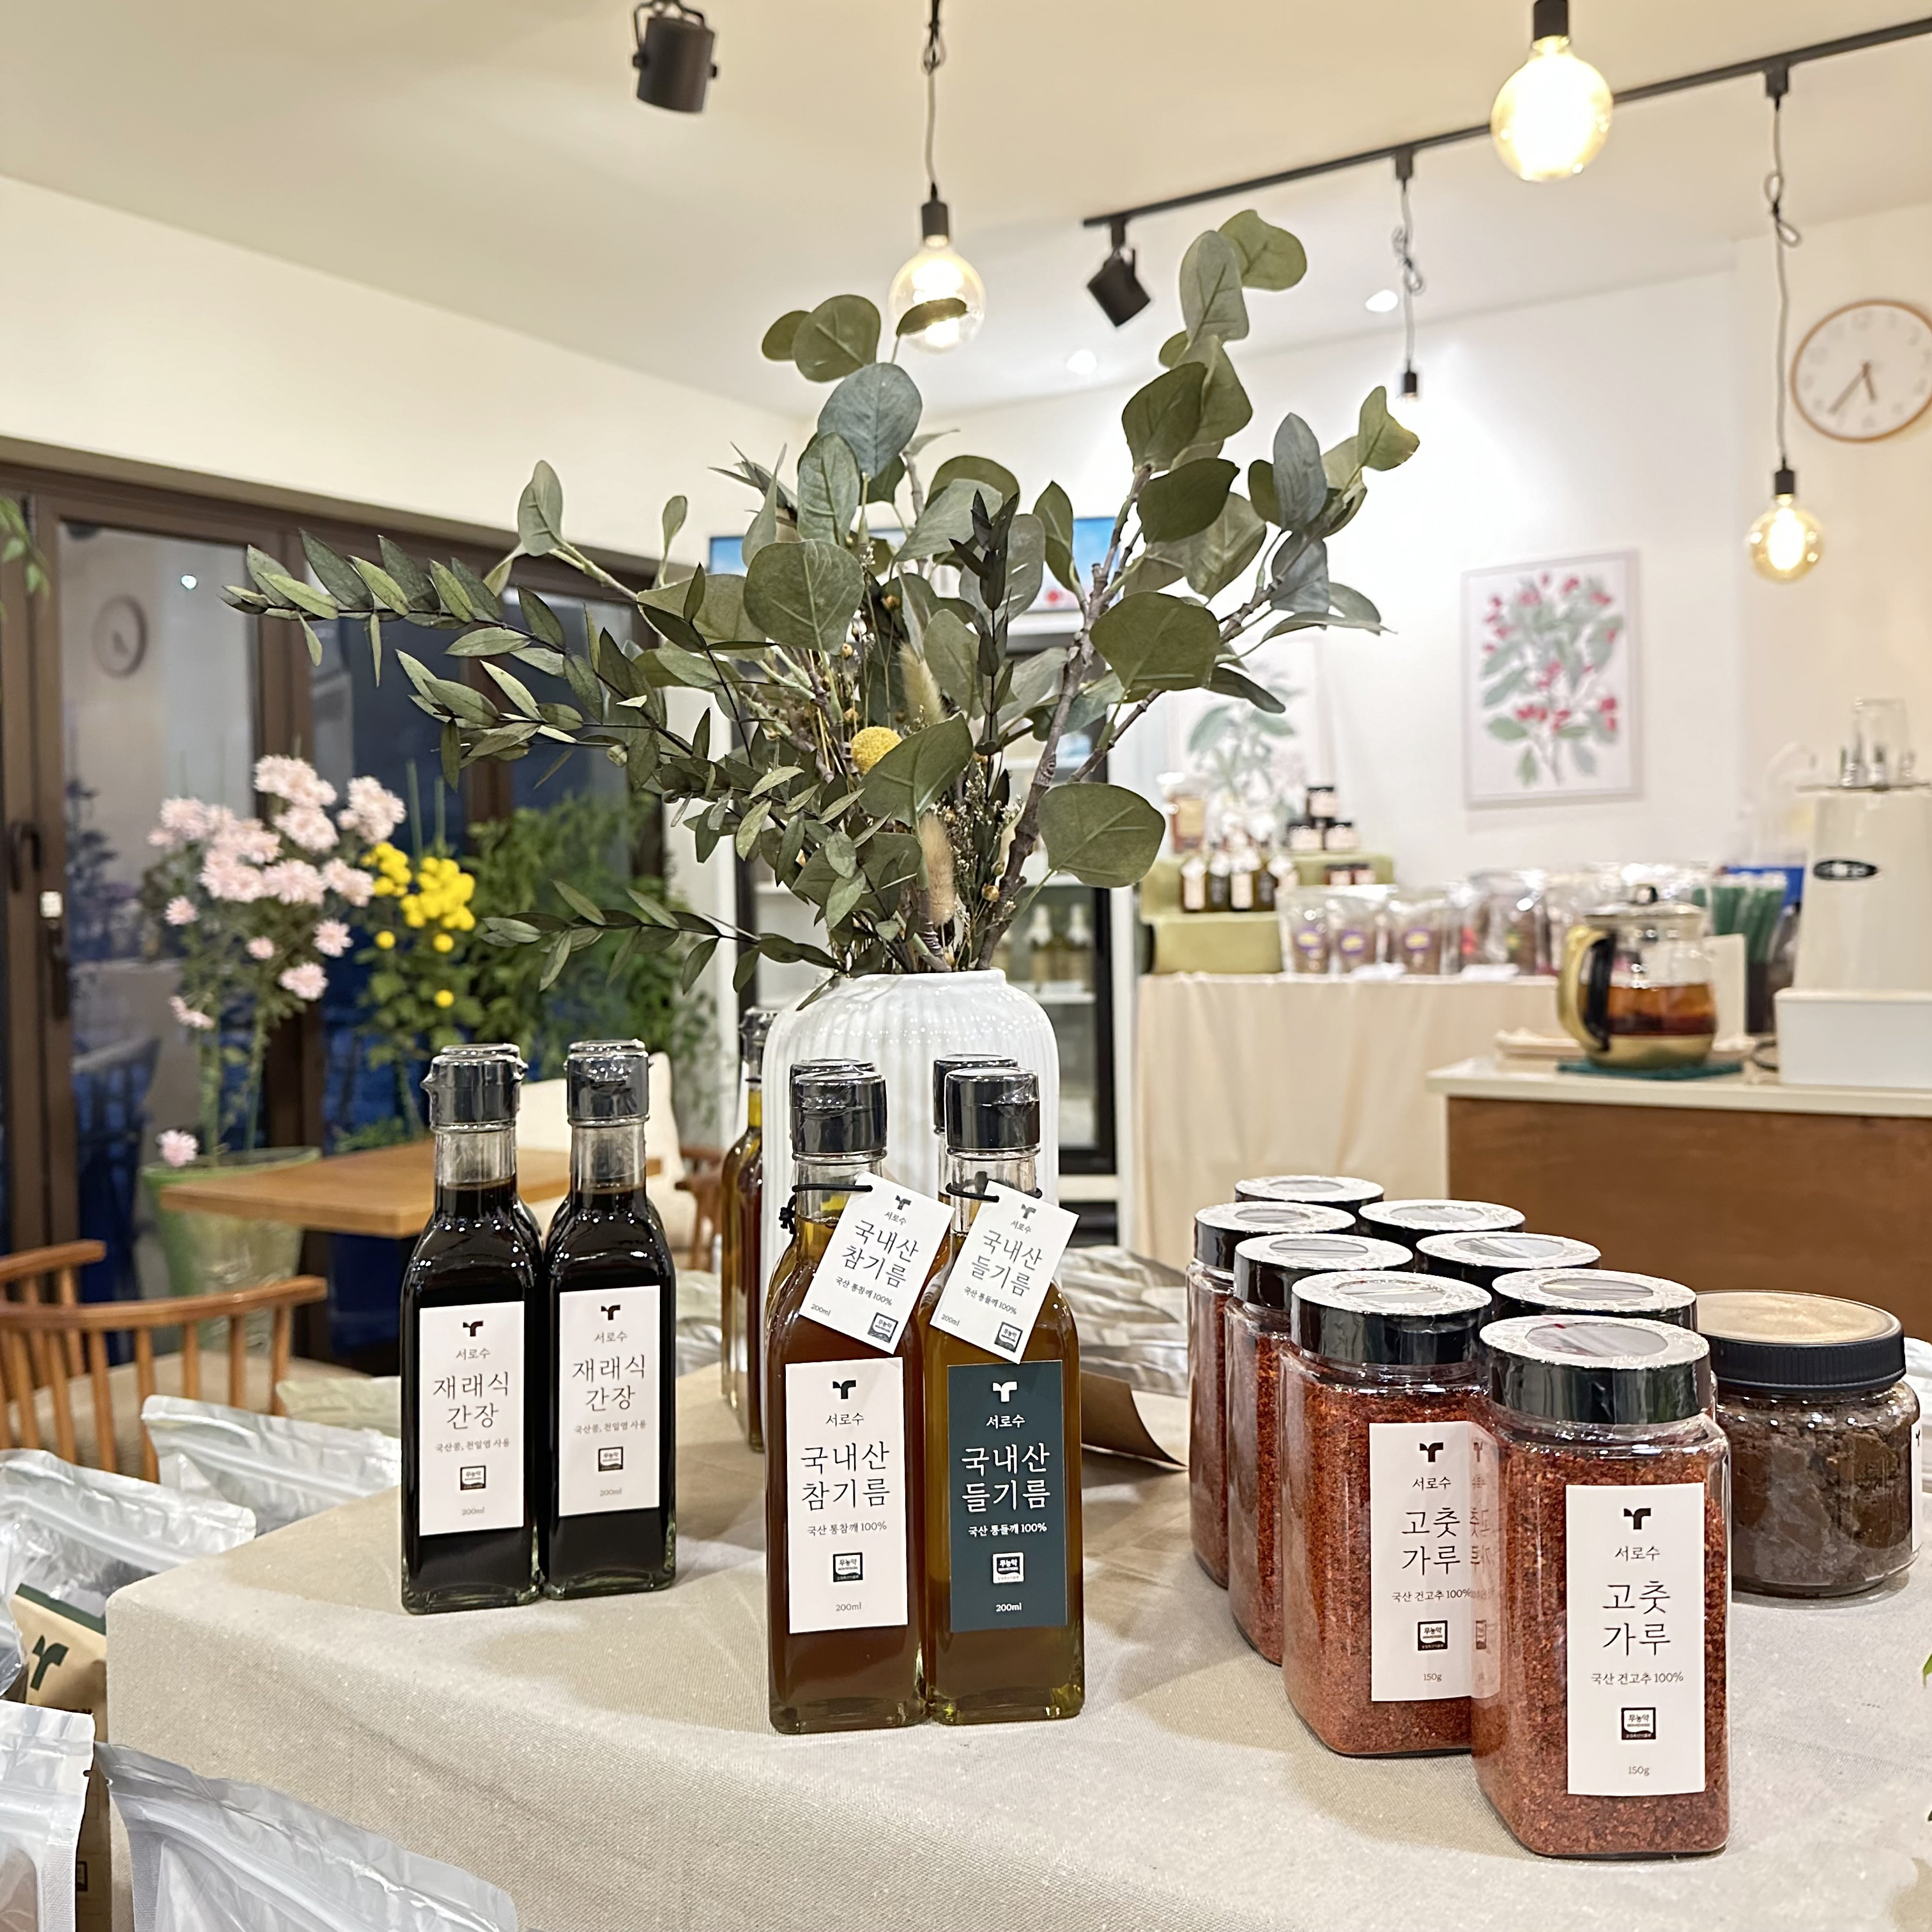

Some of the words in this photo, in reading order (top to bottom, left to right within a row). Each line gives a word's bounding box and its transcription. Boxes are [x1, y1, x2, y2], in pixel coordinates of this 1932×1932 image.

[884, 1211, 907, 1226] 서로수
[1010, 1220, 1032, 1234] 서로수
[855, 1220, 920, 1264] 국내산
[983, 1229, 1043, 1272] 국내산
[842, 1245, 907, 1289] 참기름
[972, 1255, 1031, 1297] 들기름
[836, 1276, 850, 1289] 국산
[873, 1292, 893, 1307] 100%
[964, 1285, 978, 1298] 국산
[999, 1301, 1017, 1315] 100%
[810, 1303, 831, 1317] 200ml
[941, 1313, 960, 1326] 200ml
[594, 1331, 627, 1344] 서로수
[456, 1347, 491, 1361] 서로수
[572, 1354, 645, 1383] 재래식
[433, 1371, 509, 1400] 재래식
[585, 1384, 636, 1412] 간장
[447, 1402, 499, 1430] 간장
[825, 1412, 864, 1427] 서로수
[986, 1414, 1025, 1430] 서로수
[801, 1440, 890, 1475] 국내산
[961, 1442, 1050, 1477] 국내산
[599, 1487, 622, 1497] 200ml
[1412, 1476, 1452, 1491] 서로수
[801, 1478, 891, 1512] 참기름
[962, 1479, 1051, 1513] 들기름
[461, 1506, 486, 1516] 200ml
[807, 1524, 827, 1537] 국산
[829, 1522, 858, 1535] 통참깨
[861, 1520, 887, 1531] 100%
[968, 1525, 988, 1538] 국산
[990, 1523, 1019, 1537] 통들깨
[1021, 1522, 1048, 1533] 100%
[1401, 1507, 1460, 1538] 고춧
[1402, 1545, 1461, 1576] 가루
[1614, 1545, 1660, 1562] 서로수
[1392, 1591, 1412, 1603] 국산
[1414, 1590, 1445, 1602] 건고추
[1446, 1588, 1472, 1598] 100%
[1602, 1581, 1671, 1614] 고춧
[836, 1602, 862, 1612] 200ml
[995, 1602, 1022, 1613] 200ml
[1602, 1622, 1671, 1657] 가루
[1423, 1673, 1443, 1682] 150g
[1591, 1673, 1615, 1685] 국산
[1617, 1672, 1652, 1685] 건고추
[1654, 1671, 1684, 1683] 100%
[1628, 1765, 1650, 1777] 150g
